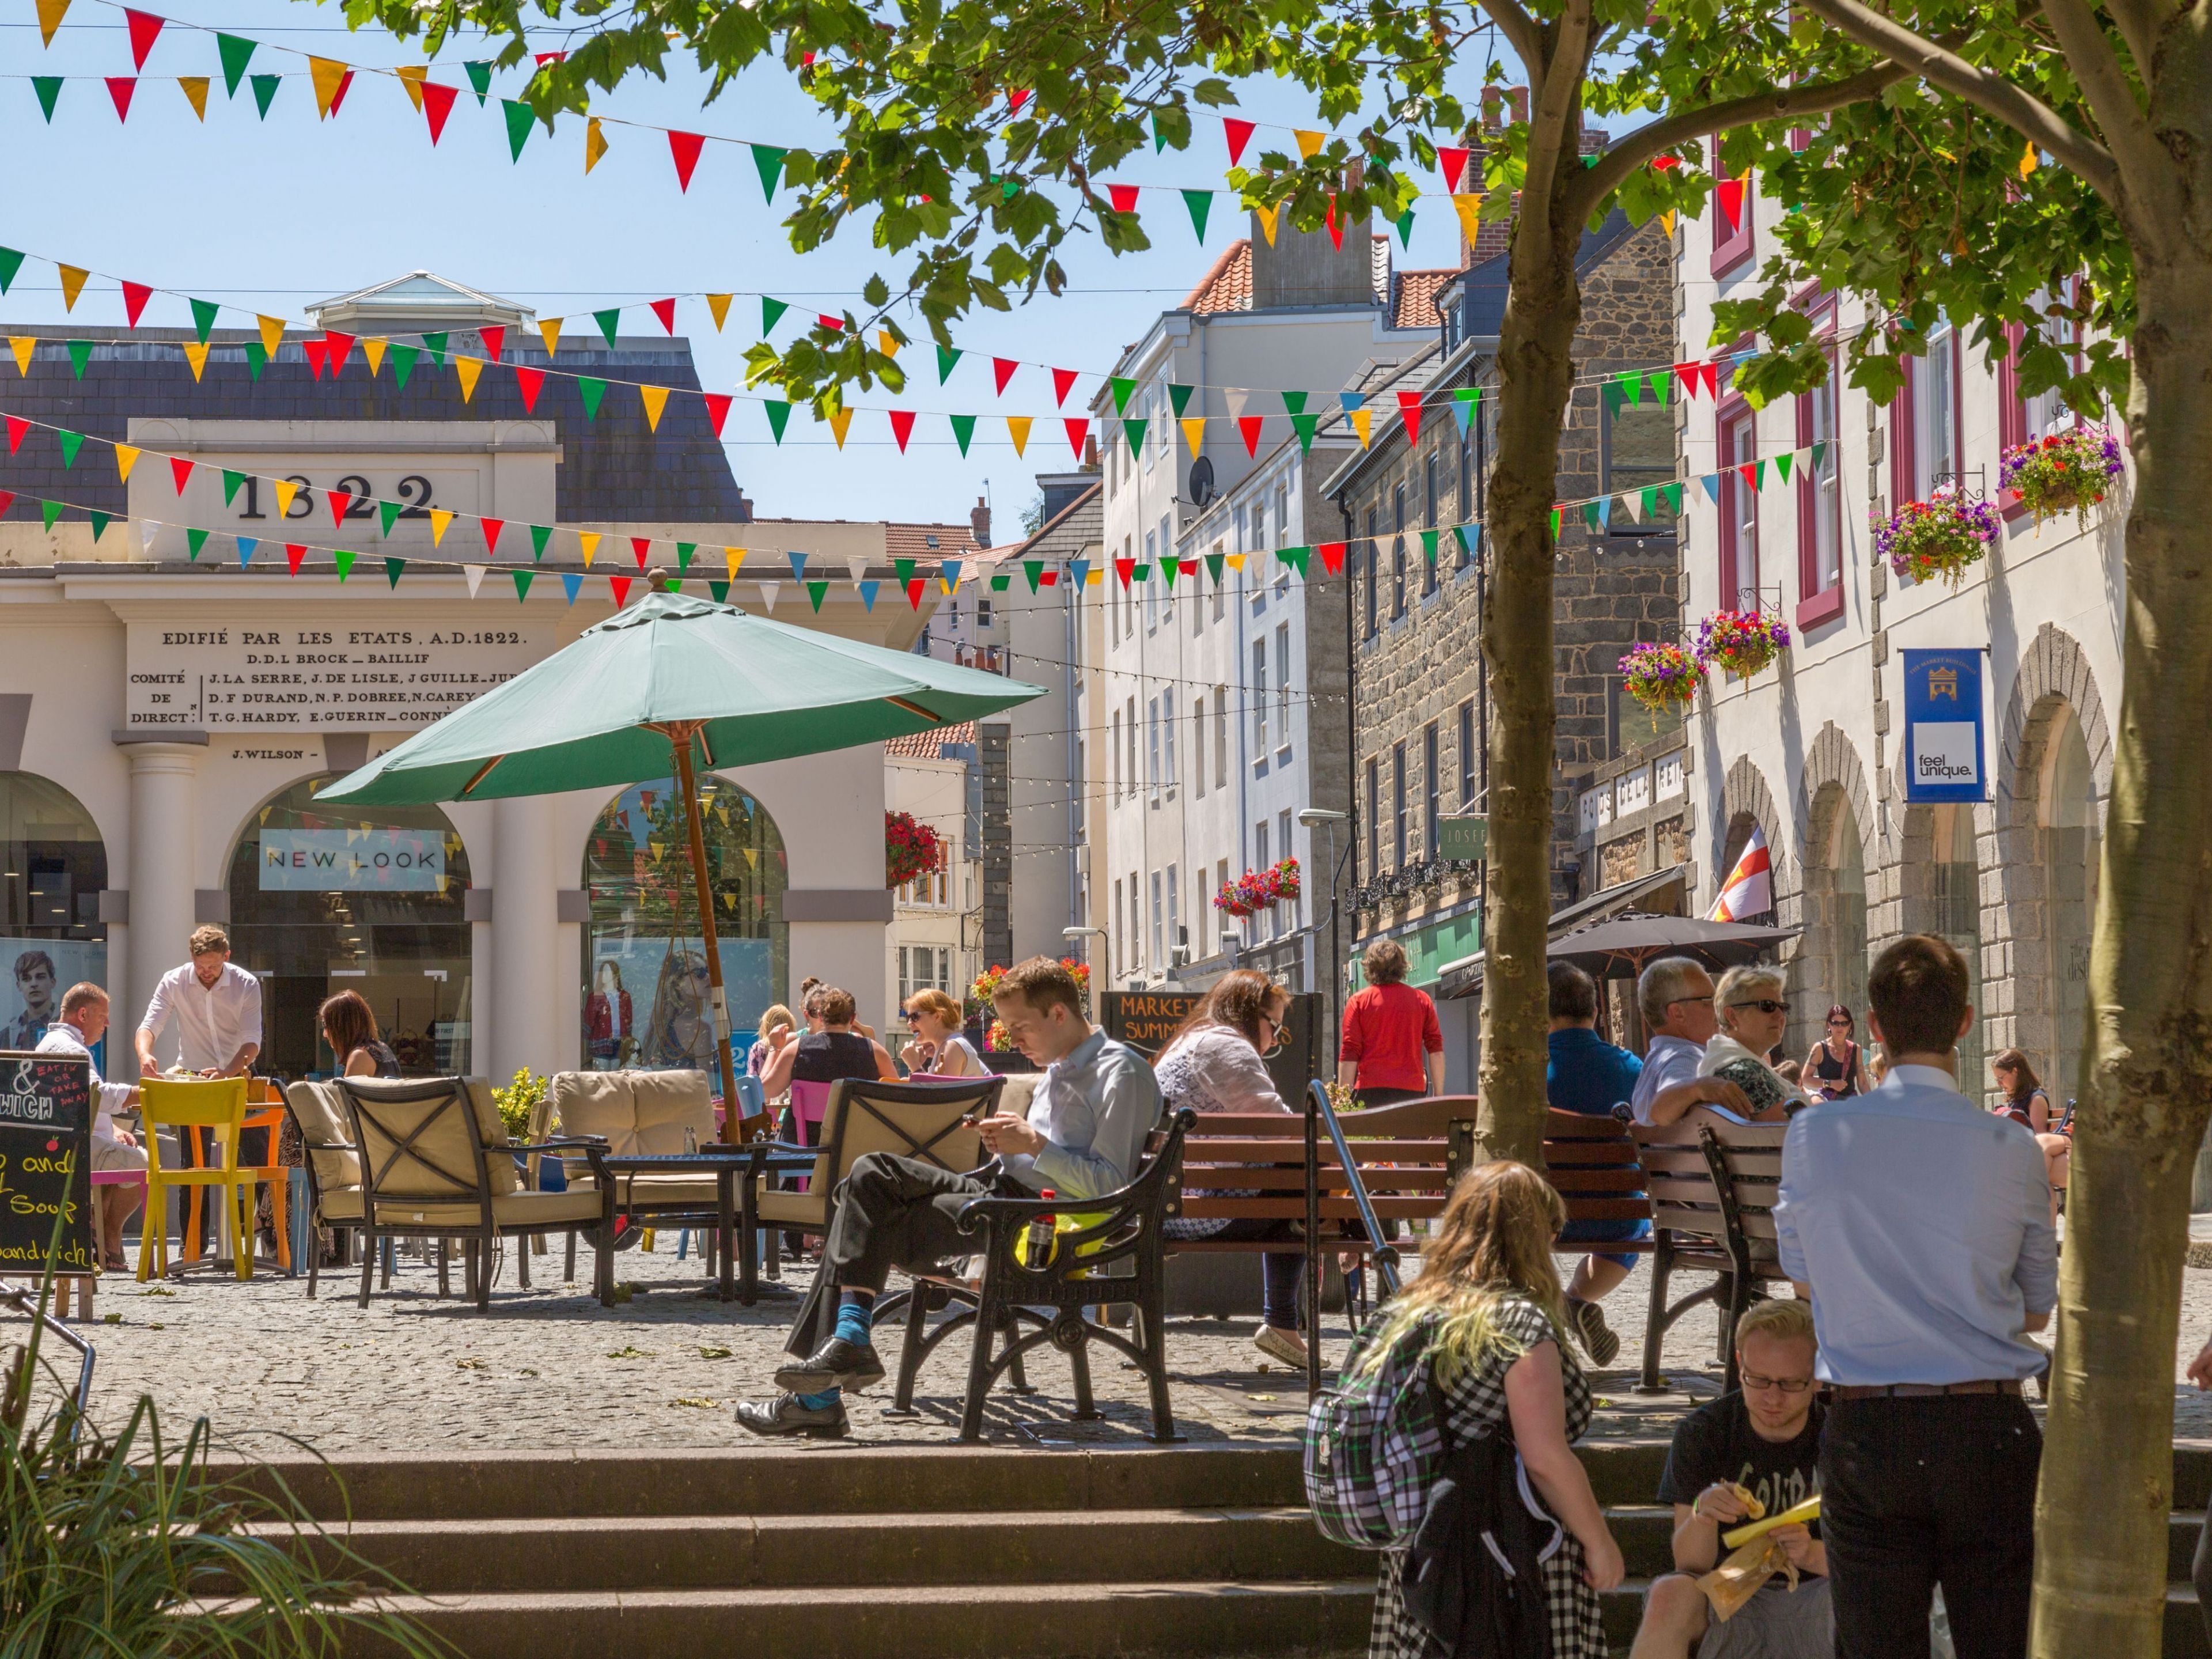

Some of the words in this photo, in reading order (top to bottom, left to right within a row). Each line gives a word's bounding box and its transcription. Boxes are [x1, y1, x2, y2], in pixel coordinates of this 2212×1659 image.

[162, 628, 228, 645] EDIFIÉ
[242, 632, 281, 645] PAR
[298, 632, 332, 645] LES
[296, 654, 348, 664] BROCK
[368, 654, 429, 664] BAILLIF
[131, 669, 185, 683] COMITÉ
[251, 674, 306, 685] SERRE,
[351, 673, 403, 684] LISLE,
[151, 694, 171, 703] DE
[1919, 754, 1945, 767] feel
[1920, 765, 1972, 779] unique.
[268, 851, 336, 868] NEW
[355, 853, 435, 868] LOOK
[12, 1058, 40, 1095] &
[36, 1065, 60, 1077] EAT
[54, 1073, 71, 1082] OR
[49, 1081, 79, 1094] TAKE
[22, 1149, 74, 1173] and
